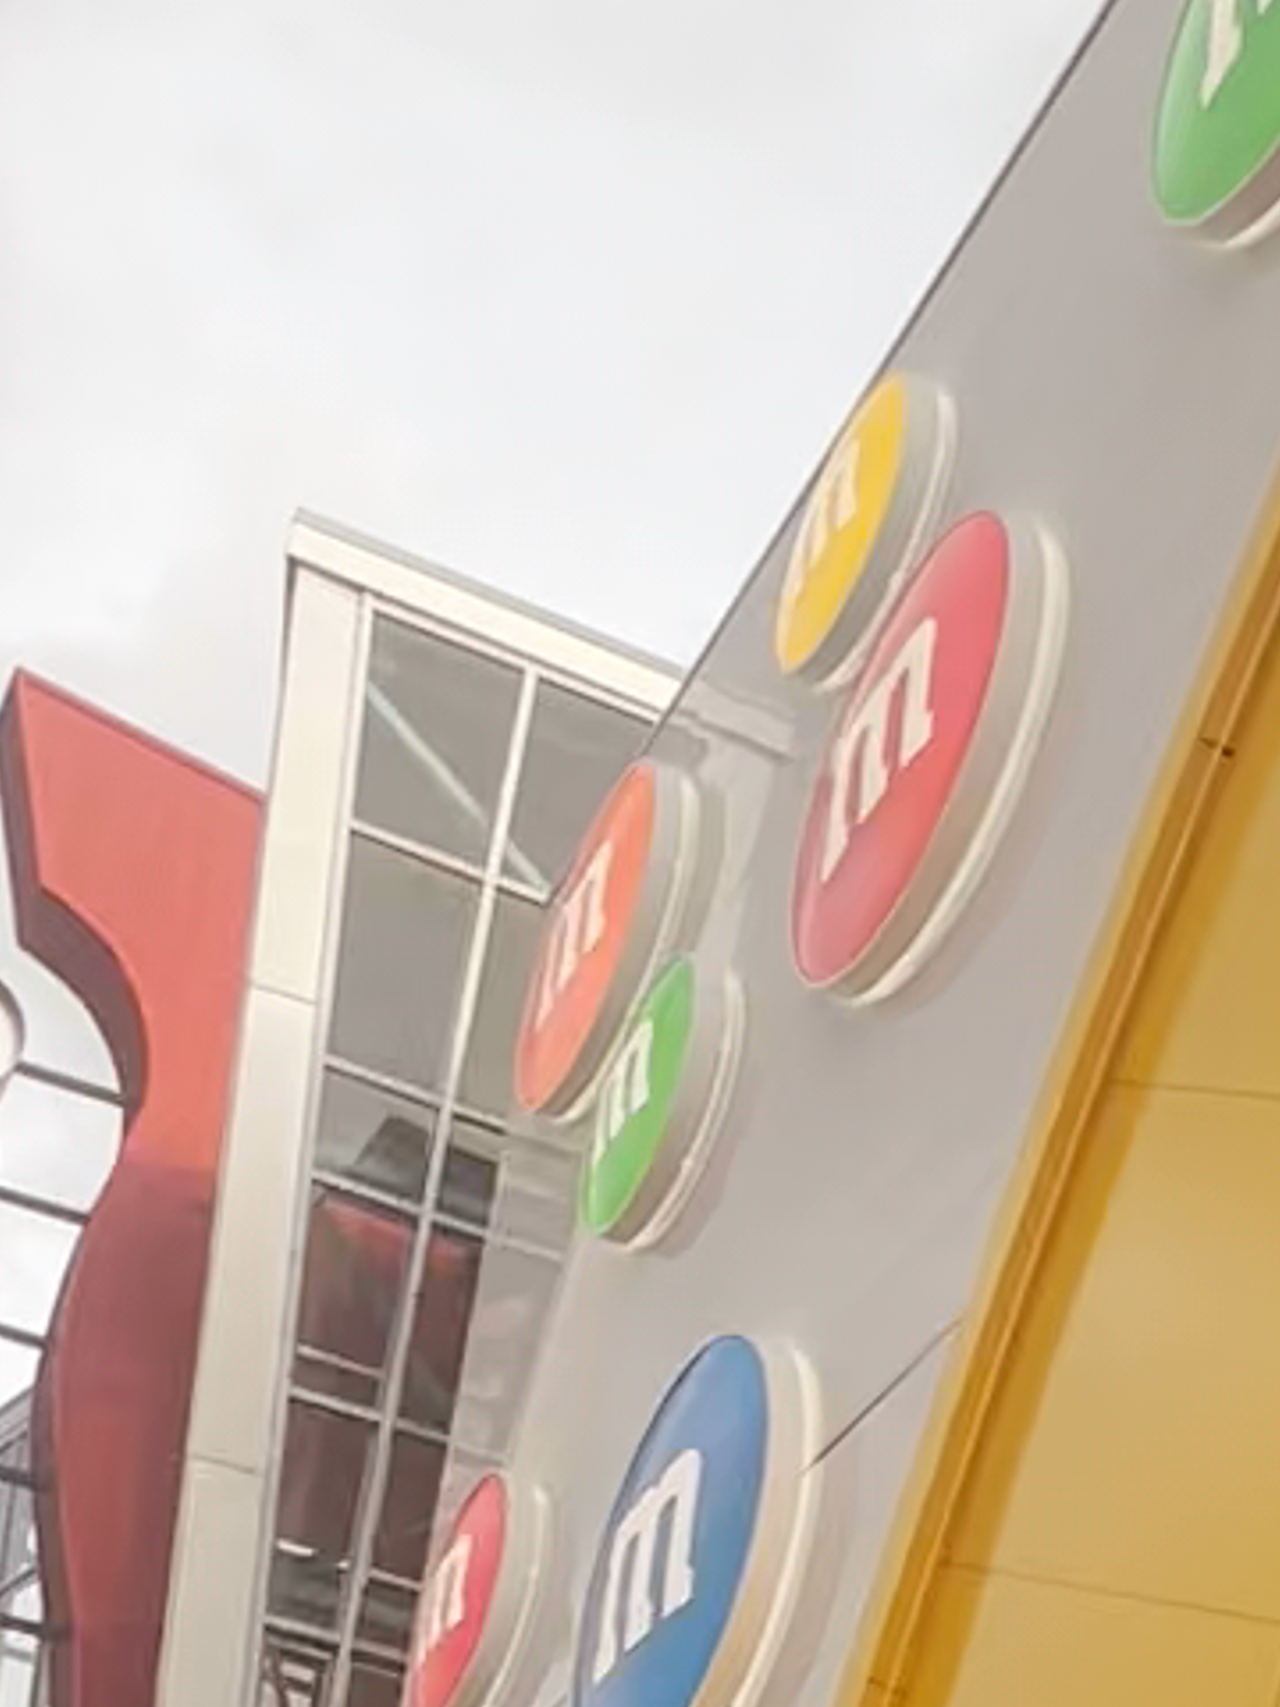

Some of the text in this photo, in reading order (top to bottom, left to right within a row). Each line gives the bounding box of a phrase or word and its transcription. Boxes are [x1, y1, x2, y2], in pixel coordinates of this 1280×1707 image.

[821, 617, 937, 883] m
[535, 839, 614, 1031] m
[592, 1019, 653, 1167] m
[593, 1448, 703, 1685] m
